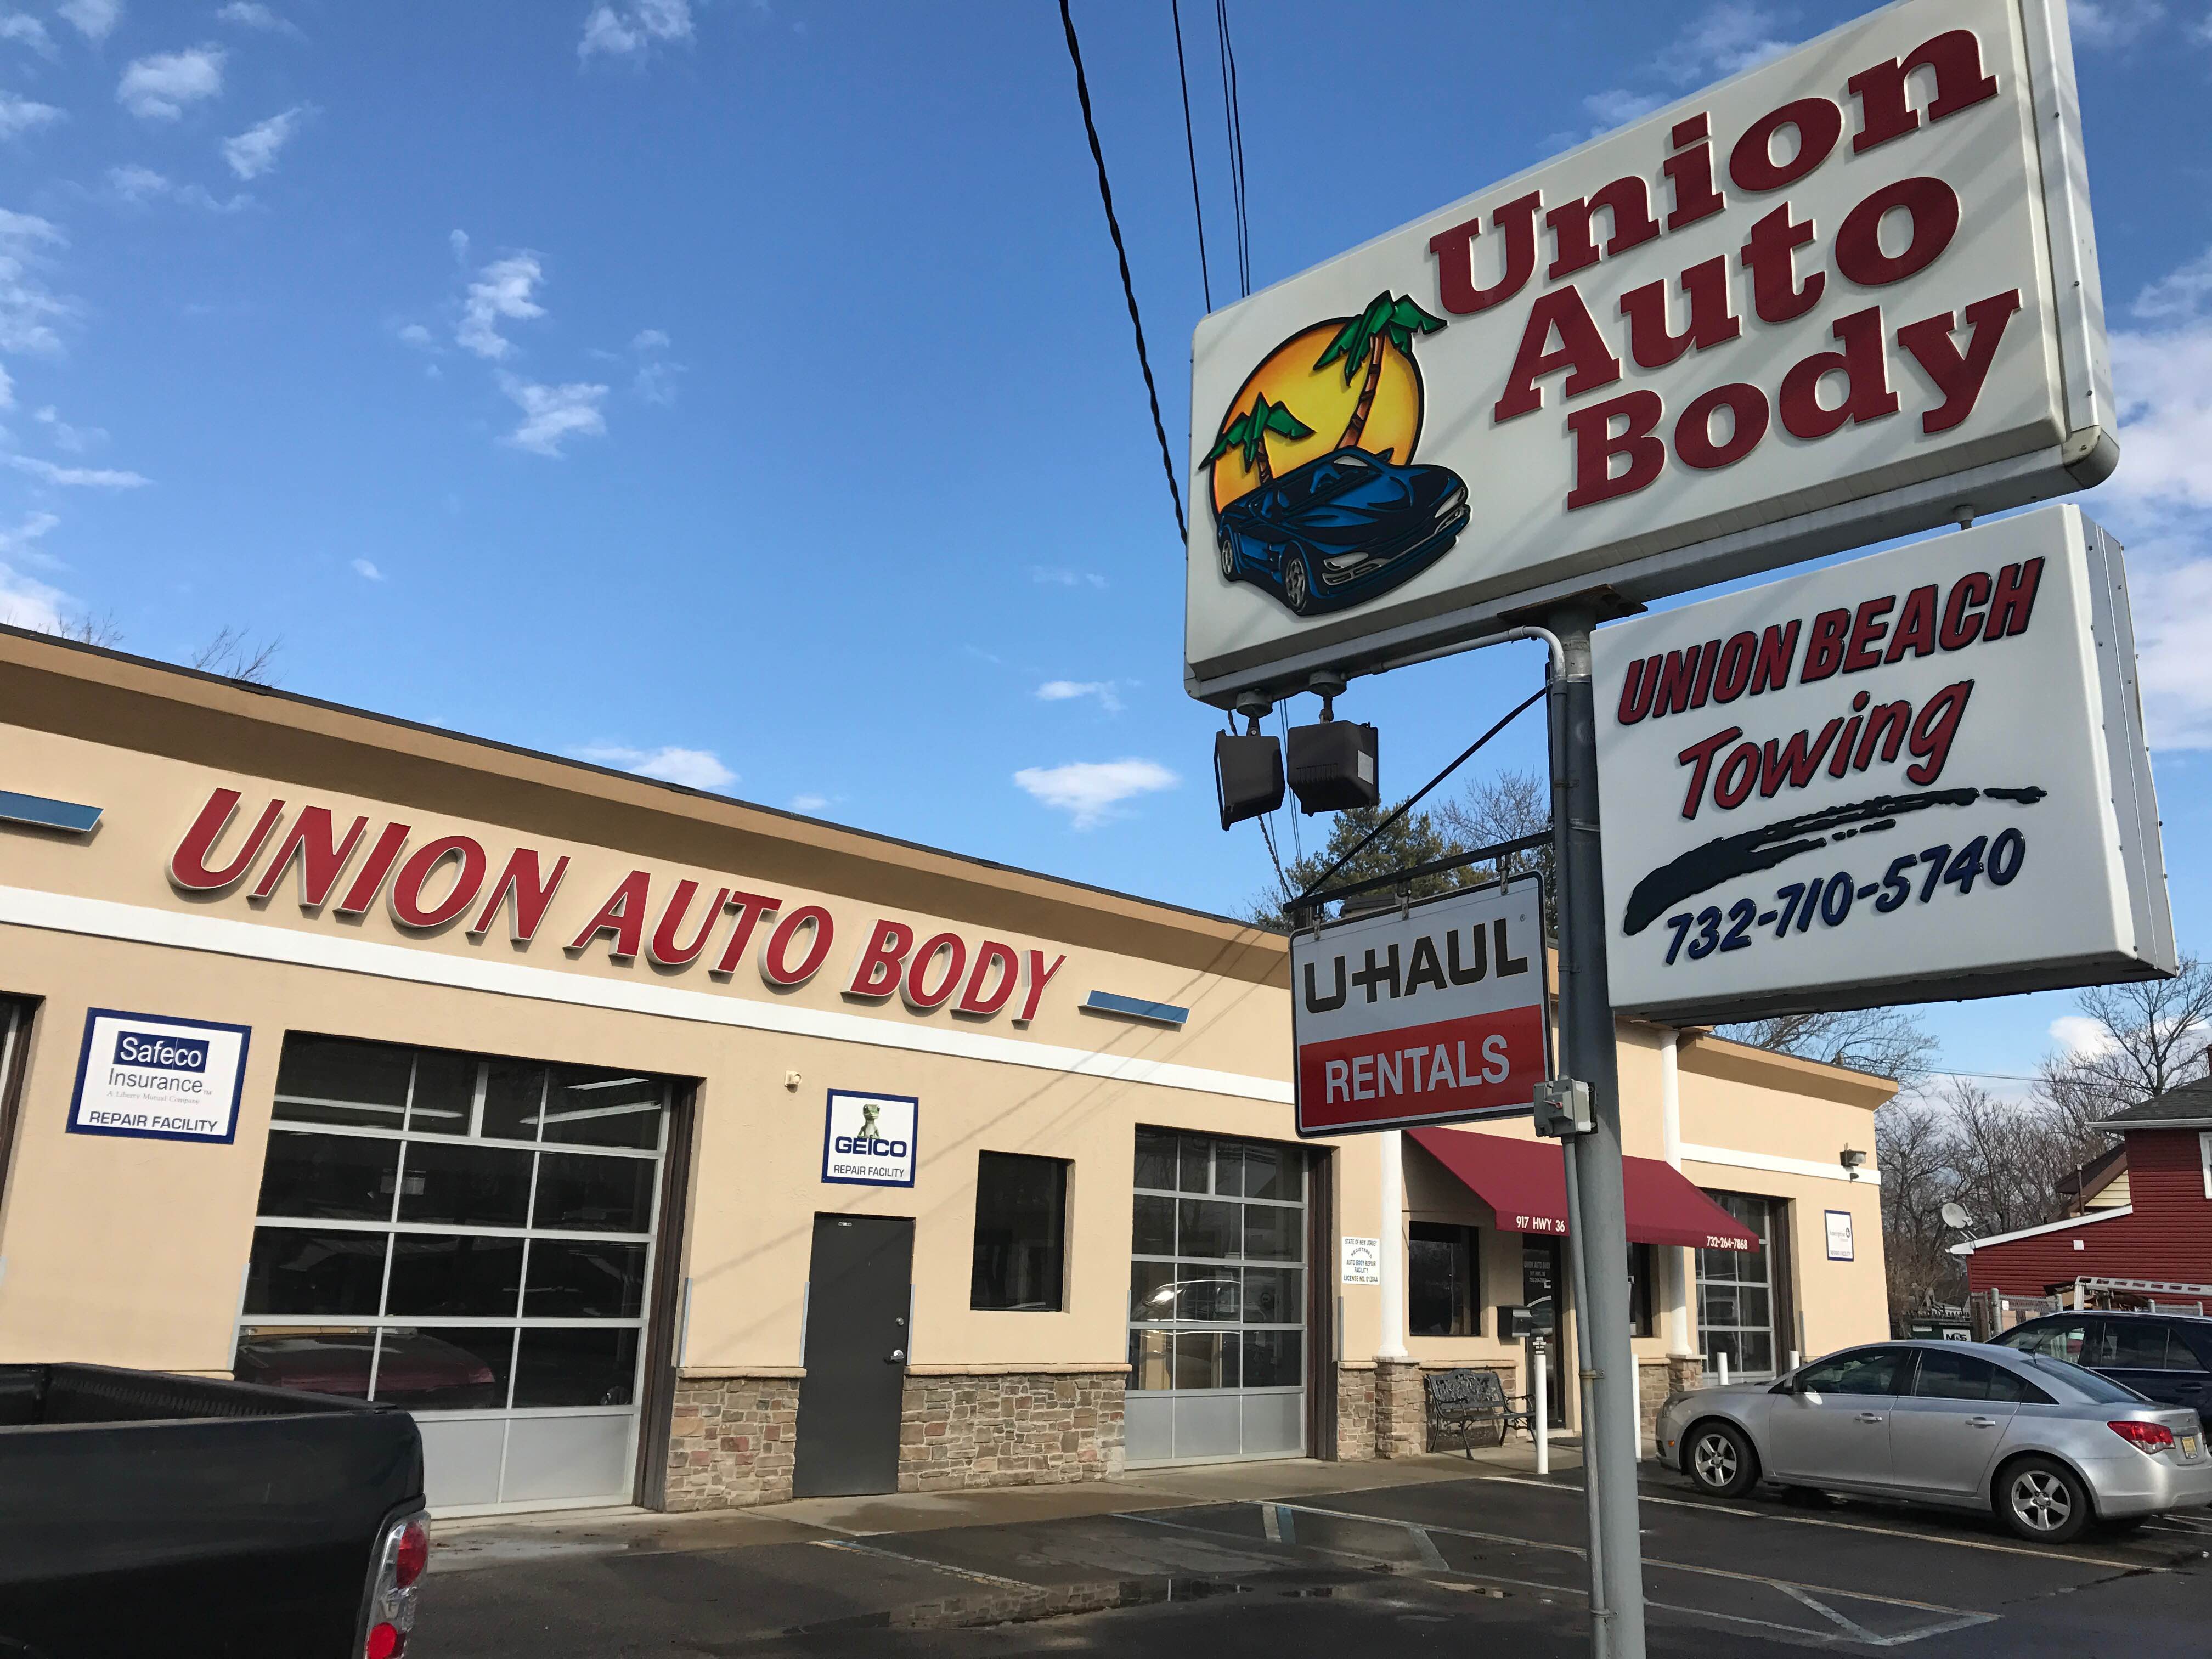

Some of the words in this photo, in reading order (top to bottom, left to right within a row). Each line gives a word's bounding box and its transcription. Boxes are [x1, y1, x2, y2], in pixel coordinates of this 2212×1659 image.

[1429, 28, 1999, 316] Union
[1495, 177, 1959, 424] Auto
[1567, 288, 2022, 511] Body
[1618, 619, 1801, 725] UNION
[1801, 556, 2045, 684] BEACH
[1678, 679, 1974, 820] Towing
[167, 787, 571, 940] UNION
[563, 870, 834, 985] AUTO
[841, 919, 1067, 1022] BODY
[1666, 827, 2025, 965] 732-710-5740
[1304, 918, 1528, 1013] U-HAUL
[109, 1068, 202, 1093] Insurance
[120, 1037, 201, 1068] Safeco
[1325, 1034, 1509, 1103] RENTALS
[89, 1111, 148, 1127] REPAIR
[152, 1116, 218, 1132] FACILITY
[169, 1095, 200, 1104] Company
[834, 1164, 866, 1175] REPAIR
[868, 1167, 904, 1177] FACILITY
[835, 1136, 907, 1157] GEICO
[1516, 1216, 1529, 1228] 917
[1533, 1217, 1552, 1231] HWY
[1555, 1220, 1565, 1232] 36
[1707, 1235, 1747, 1250] 732-264-7868
